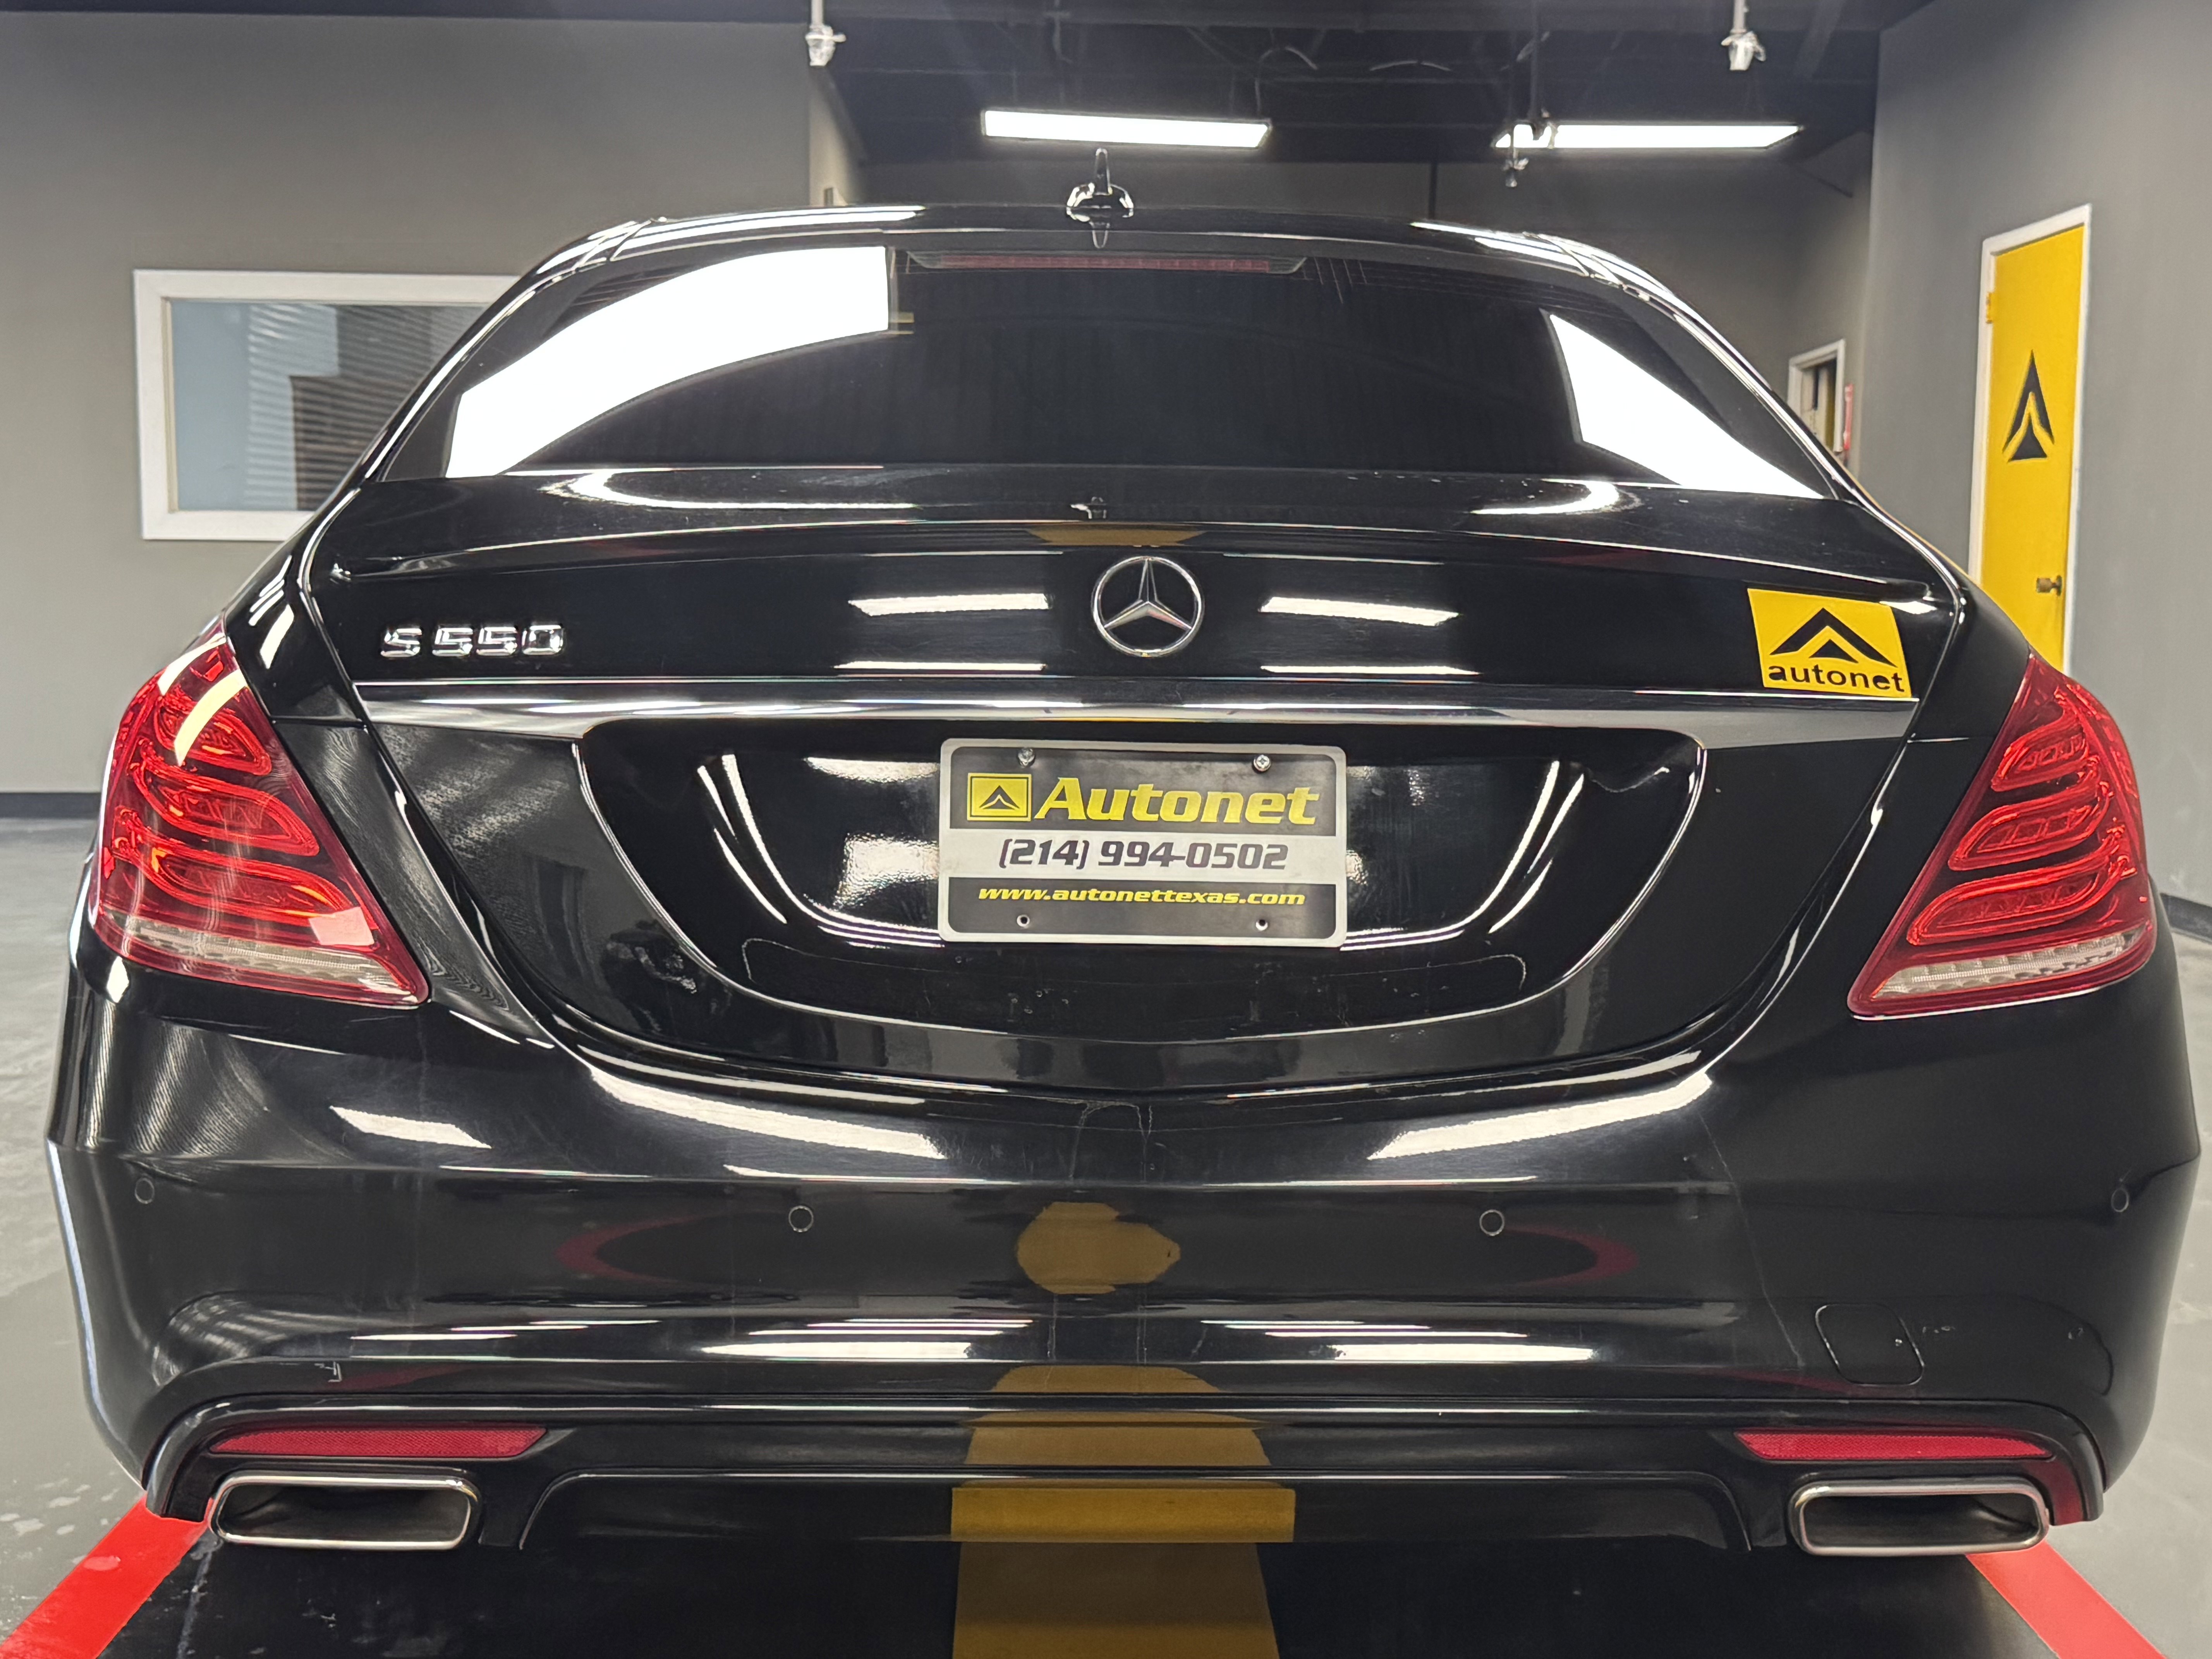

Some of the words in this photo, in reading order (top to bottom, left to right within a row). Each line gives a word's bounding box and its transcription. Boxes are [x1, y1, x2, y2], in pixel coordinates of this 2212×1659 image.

[1768, 664, 1905, 692] autonet
[1034, 777, 1320, 825] Autonet
[998, 838, 1090, 869] (214)
[1098, 841, 1289, 870] 994-0502
[978, 886, 1306, 905] www.autonettexas.com
